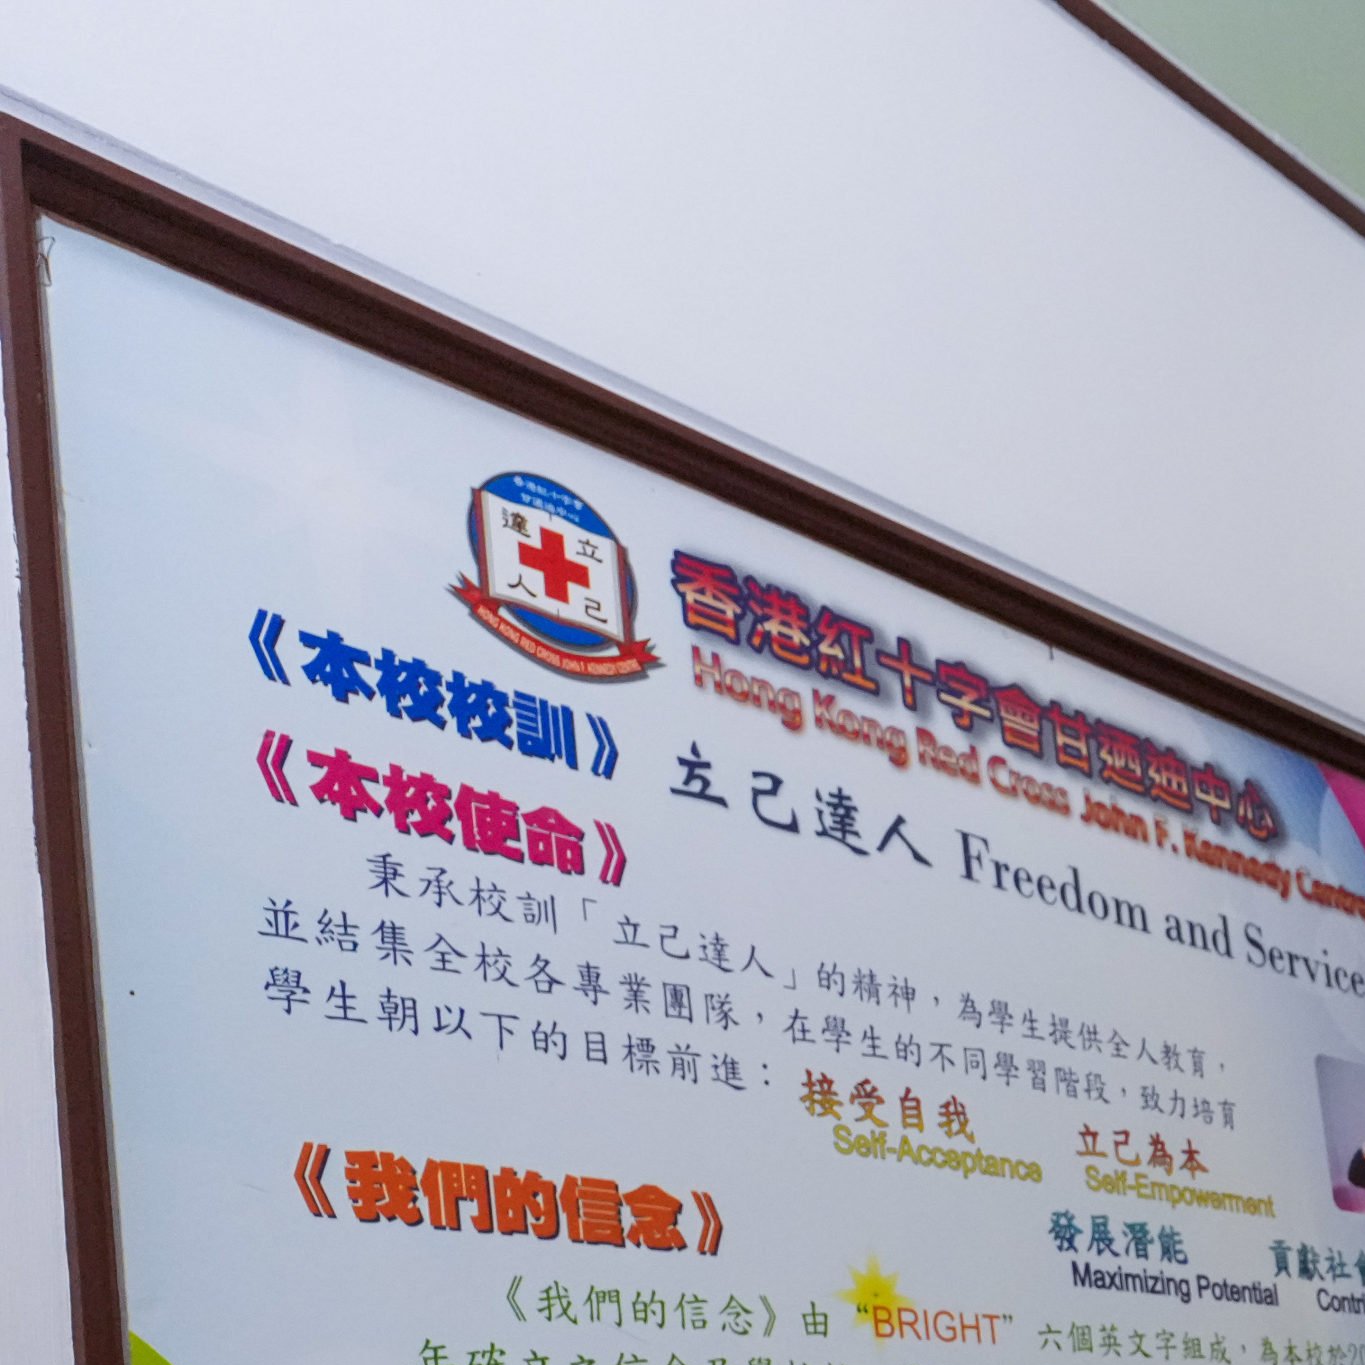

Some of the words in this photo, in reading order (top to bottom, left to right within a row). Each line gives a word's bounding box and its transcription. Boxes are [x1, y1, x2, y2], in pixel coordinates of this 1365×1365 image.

[576, 539, 603, 563] 立
[508, 574, 537, 598] 人
[584, 597, 608, 624] 己
[248, 608, 620, 780] 《本校校訓》
[671, 548, 1280, 841] 香港紅十字會甘迺迪中心
[690, 644, 806, 732] Hong
[811, 686, 911, 769] Kong
[914, 728, 982, 787] Red
[988, 756, 1072, 815] Cross
[1080, 788, 1149, 842] John
[1153, 818, 1179, 857] F.
[1183, 830, 1293, 900] Kennedy
[255, 729, 628, 887] 《本校使命》
[670, 740, 932, 869] 立己達人
[955, 828, 1152, 935] Freedom
[1164, 914, 1232, 960] and
[799, 1067, 976, 1143] 接受自我
[832, 1123, 1043, 1184] Self-Acceptance
[1075, 1123, 1210, 1180] 立己為本
[293, 1141, 724, 1256] 《我們的信念》
[1084, 1165, 1278, 1219] Self-Empowerment
[1047, 1209, 1189, 1266] 發展潛能
[1071, 1260, 1192, 1304] Maximizing
[1198, 1273, 1280, 1307] Potential
